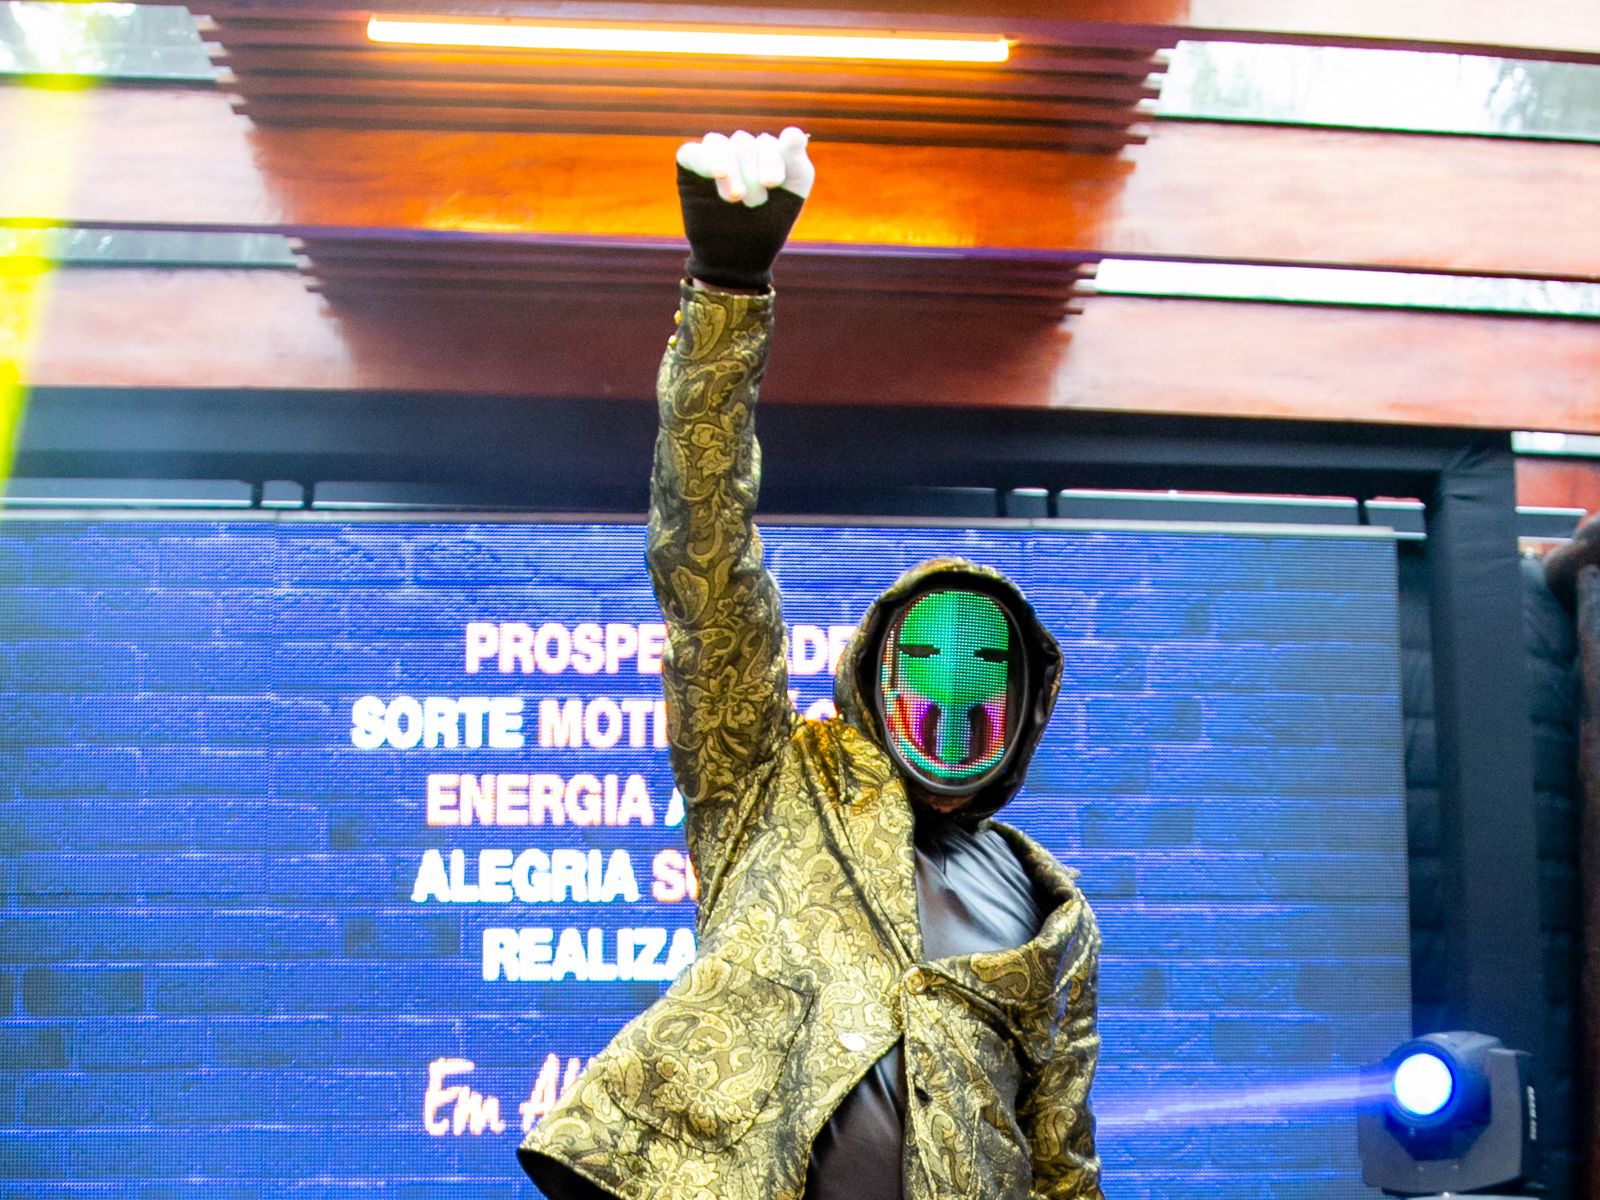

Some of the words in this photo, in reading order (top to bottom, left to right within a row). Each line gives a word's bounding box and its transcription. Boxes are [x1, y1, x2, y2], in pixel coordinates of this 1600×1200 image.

[351, 697, 523, 749] SORTE
[427, 774, 654, 826] ENERGIA
[412, 849, 639, 902] ALEGRIA
[483, 928, 697, 981] REALIZA
[424, 1058, 506, 1135] Em
